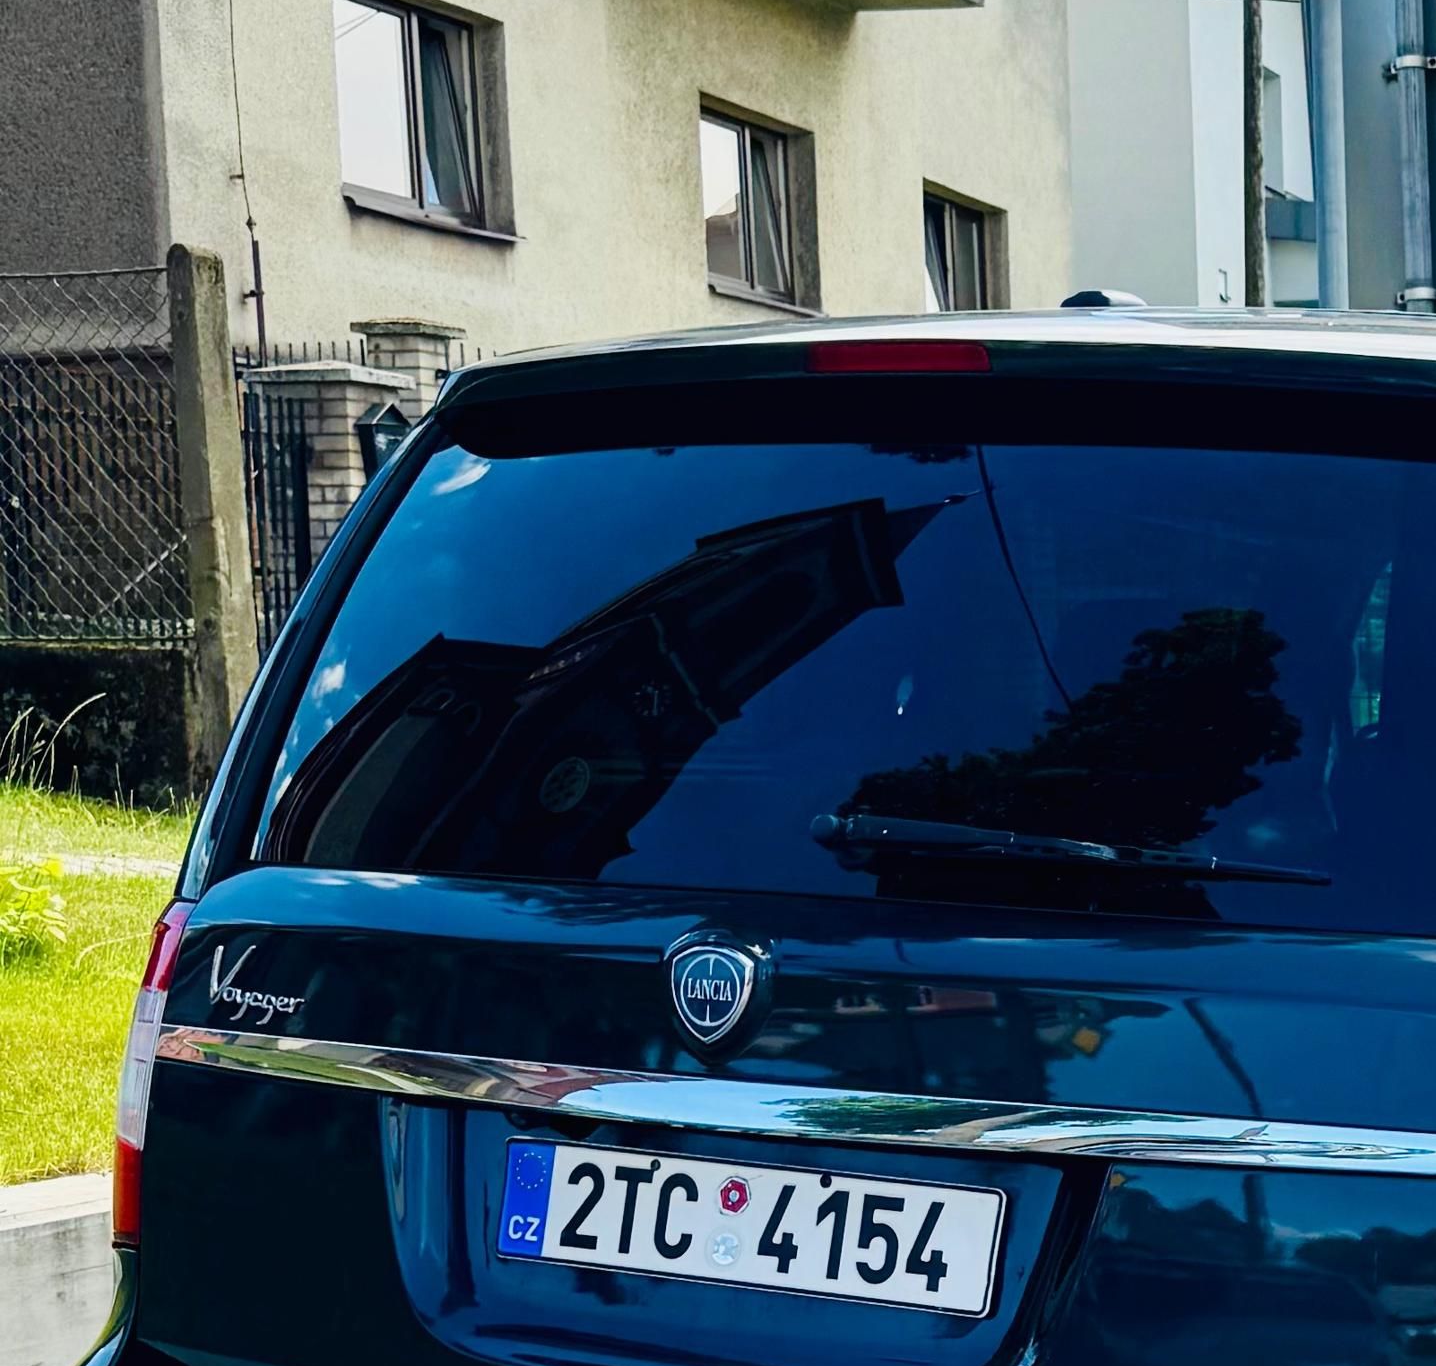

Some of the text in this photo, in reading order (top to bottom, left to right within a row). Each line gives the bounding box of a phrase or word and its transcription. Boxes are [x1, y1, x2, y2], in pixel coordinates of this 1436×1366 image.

[210, 945, 305, 1025] Voyager
[687, 977, 733, 1001] LANCIA
[508, 1214, 541, 1242] CZ
[559, 1161, 949, 1292] 2TC 4154
